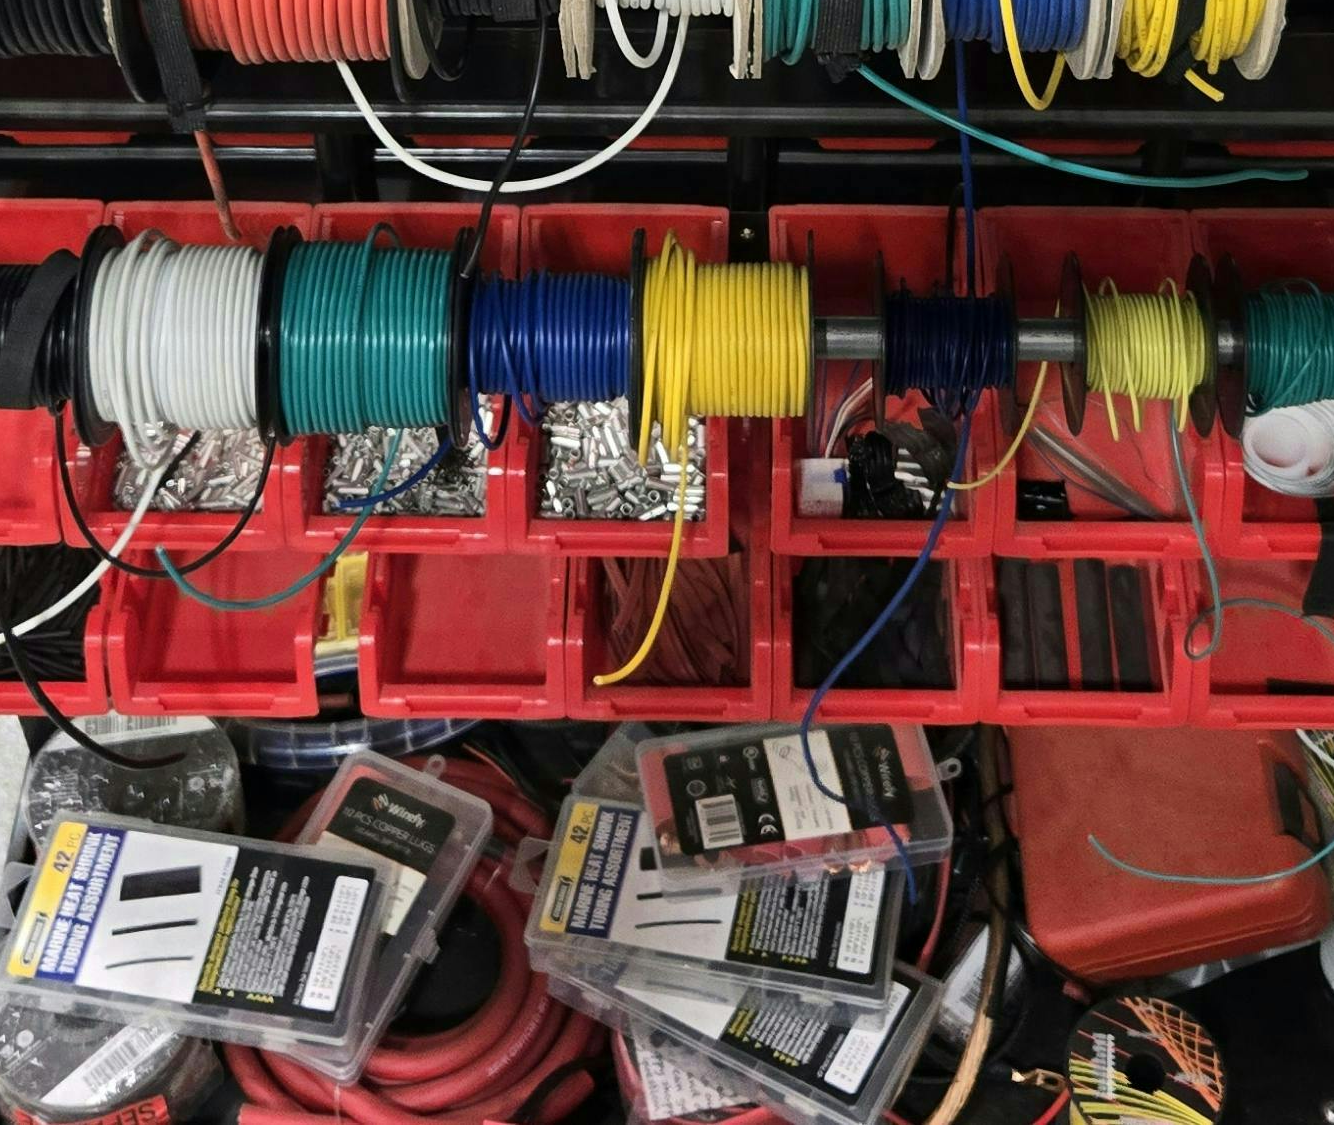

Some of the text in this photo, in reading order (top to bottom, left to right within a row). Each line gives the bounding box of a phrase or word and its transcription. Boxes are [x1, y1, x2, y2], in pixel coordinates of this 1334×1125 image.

[53, 851, 73, 874] 42
[570, 825, 590, 844] 42
[570, 811, 616, 929] MARINE HEAT SHRINK
[588, 812, 635, 930] TUBING ASSORTMENT
[39, 832, 104, 972] MARINE HEAT SHRINK
[57, 833, 121, 974] TUBING ASSORTMENT
